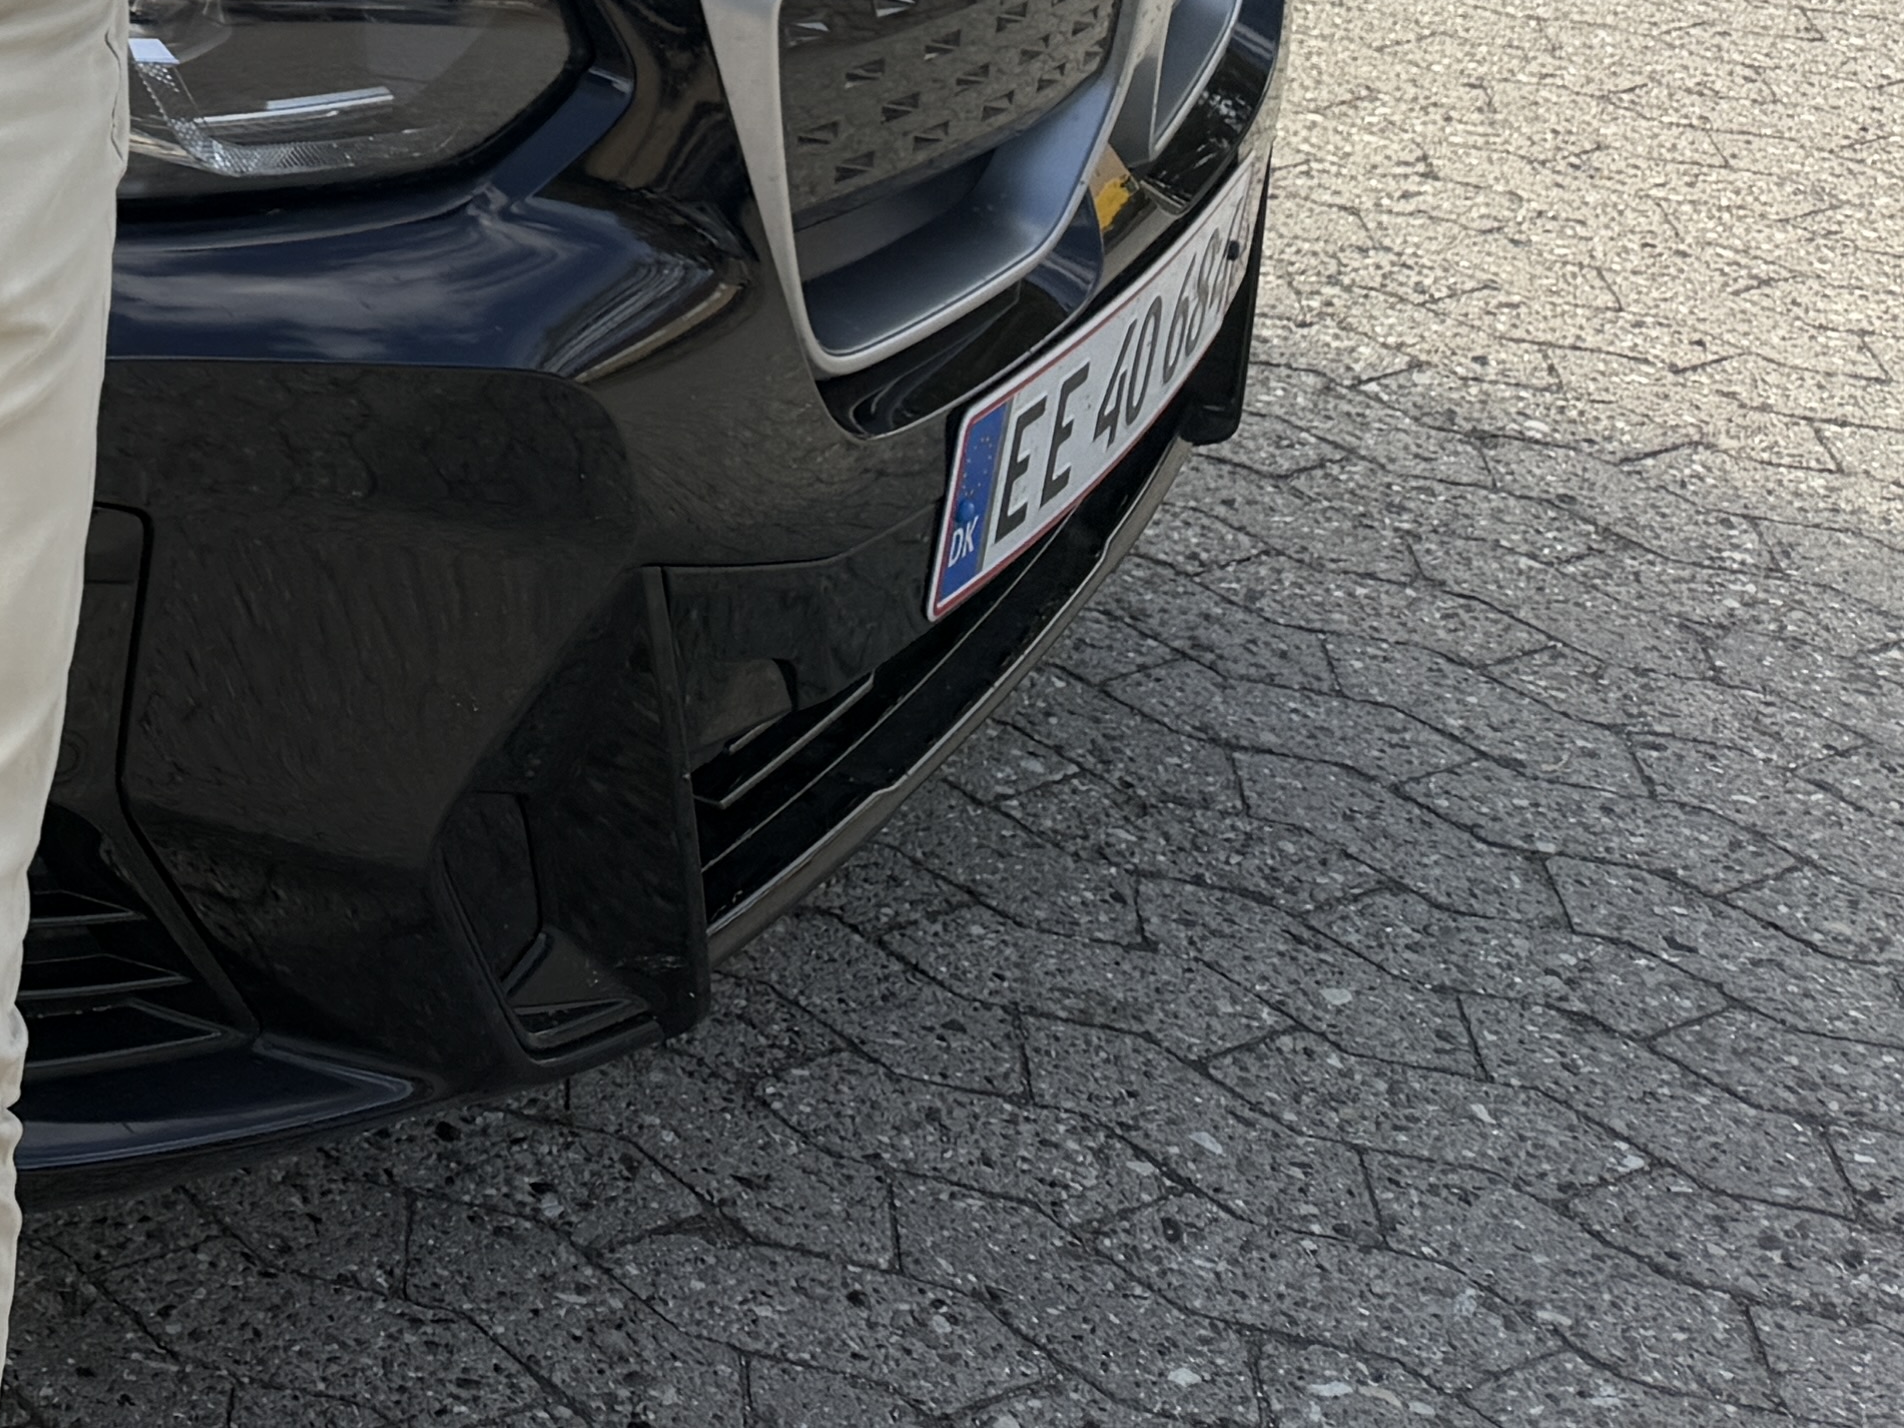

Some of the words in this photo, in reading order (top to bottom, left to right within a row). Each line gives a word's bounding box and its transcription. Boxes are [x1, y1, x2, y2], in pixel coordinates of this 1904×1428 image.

[994, 361, 1090, 544] EE
[1093, 295, 1163, 449] 40
[947, 514, 980, 568] DK
